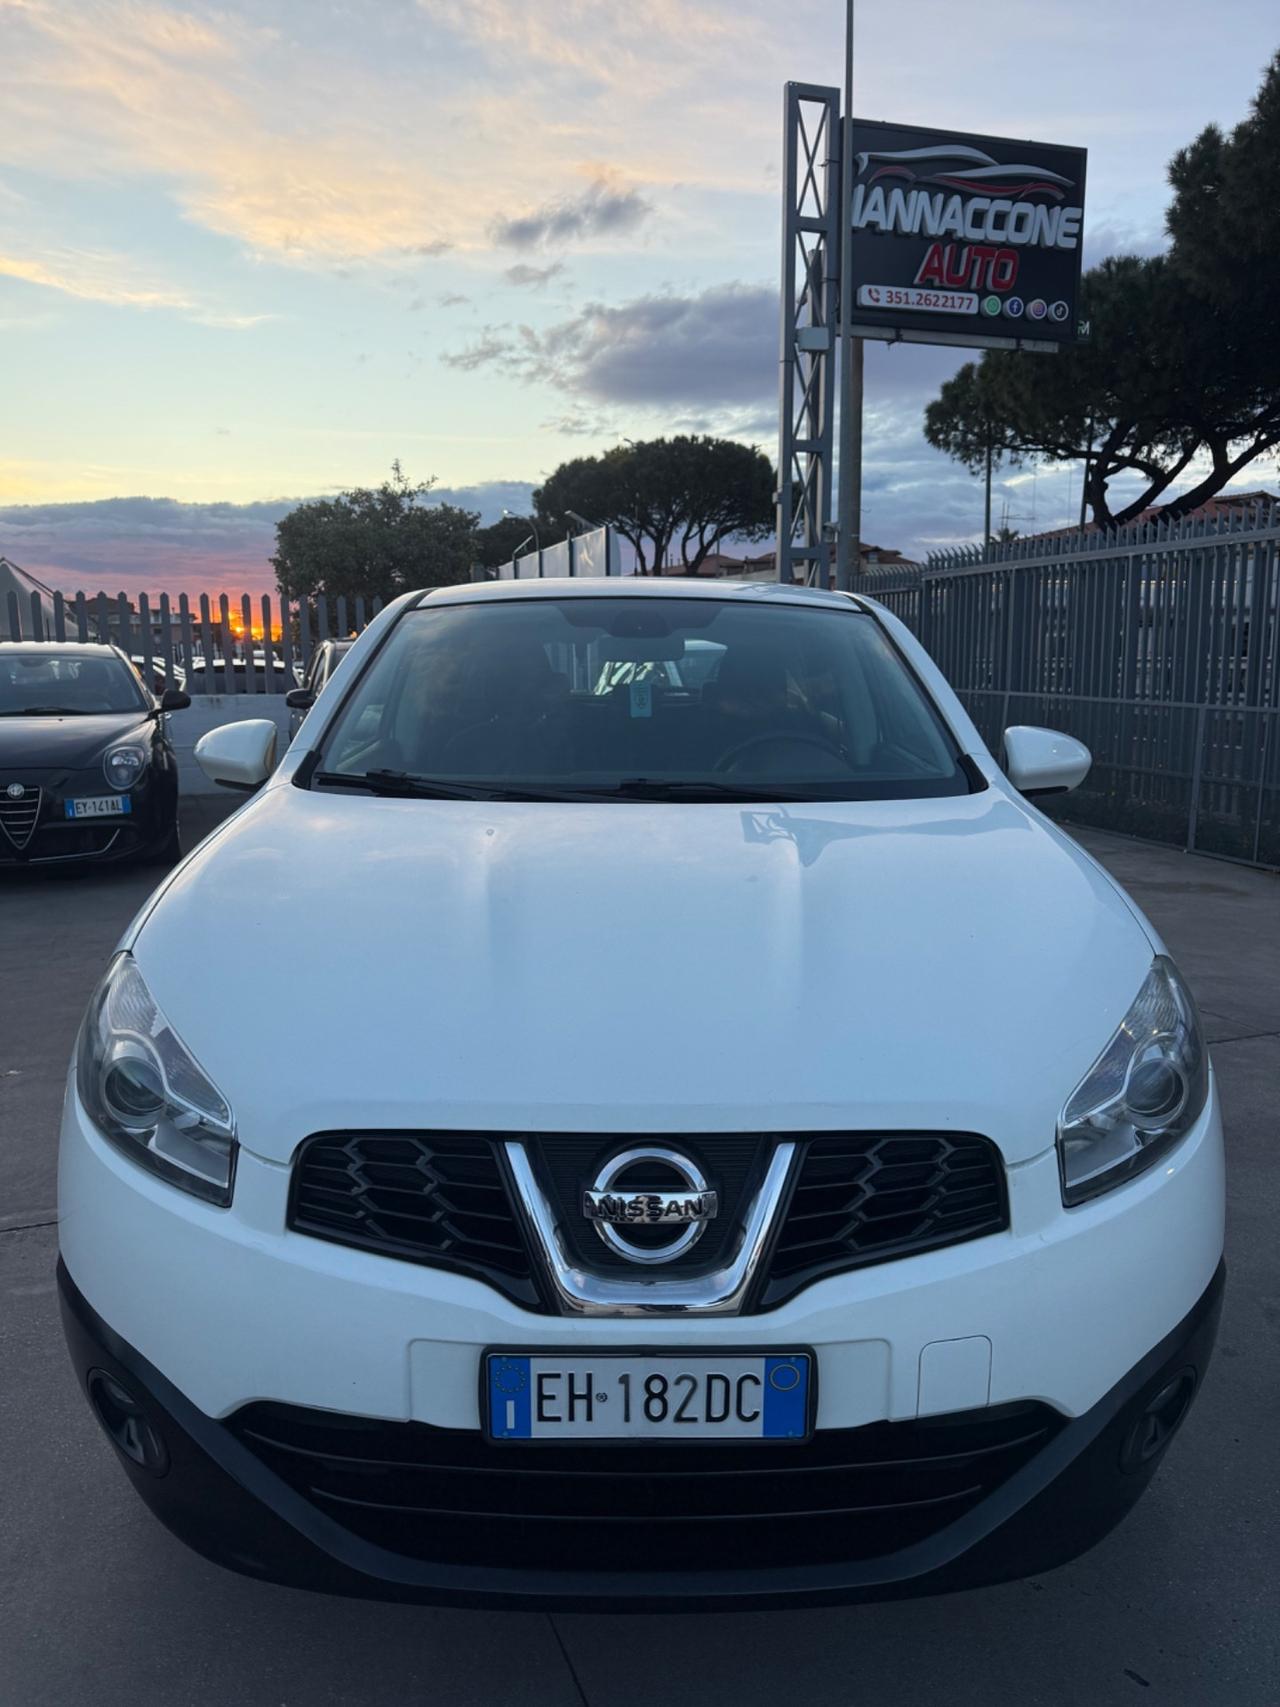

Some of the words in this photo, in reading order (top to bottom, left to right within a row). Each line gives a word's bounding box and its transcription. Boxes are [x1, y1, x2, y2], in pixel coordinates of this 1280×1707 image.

[852, 184, 1083, 249] IANNACCONE
[914, 242, 1019, 292] AUTO
[886, 290, 973, 311] 351.2622177
[597, 1196, 702, 1217] NISSAN
